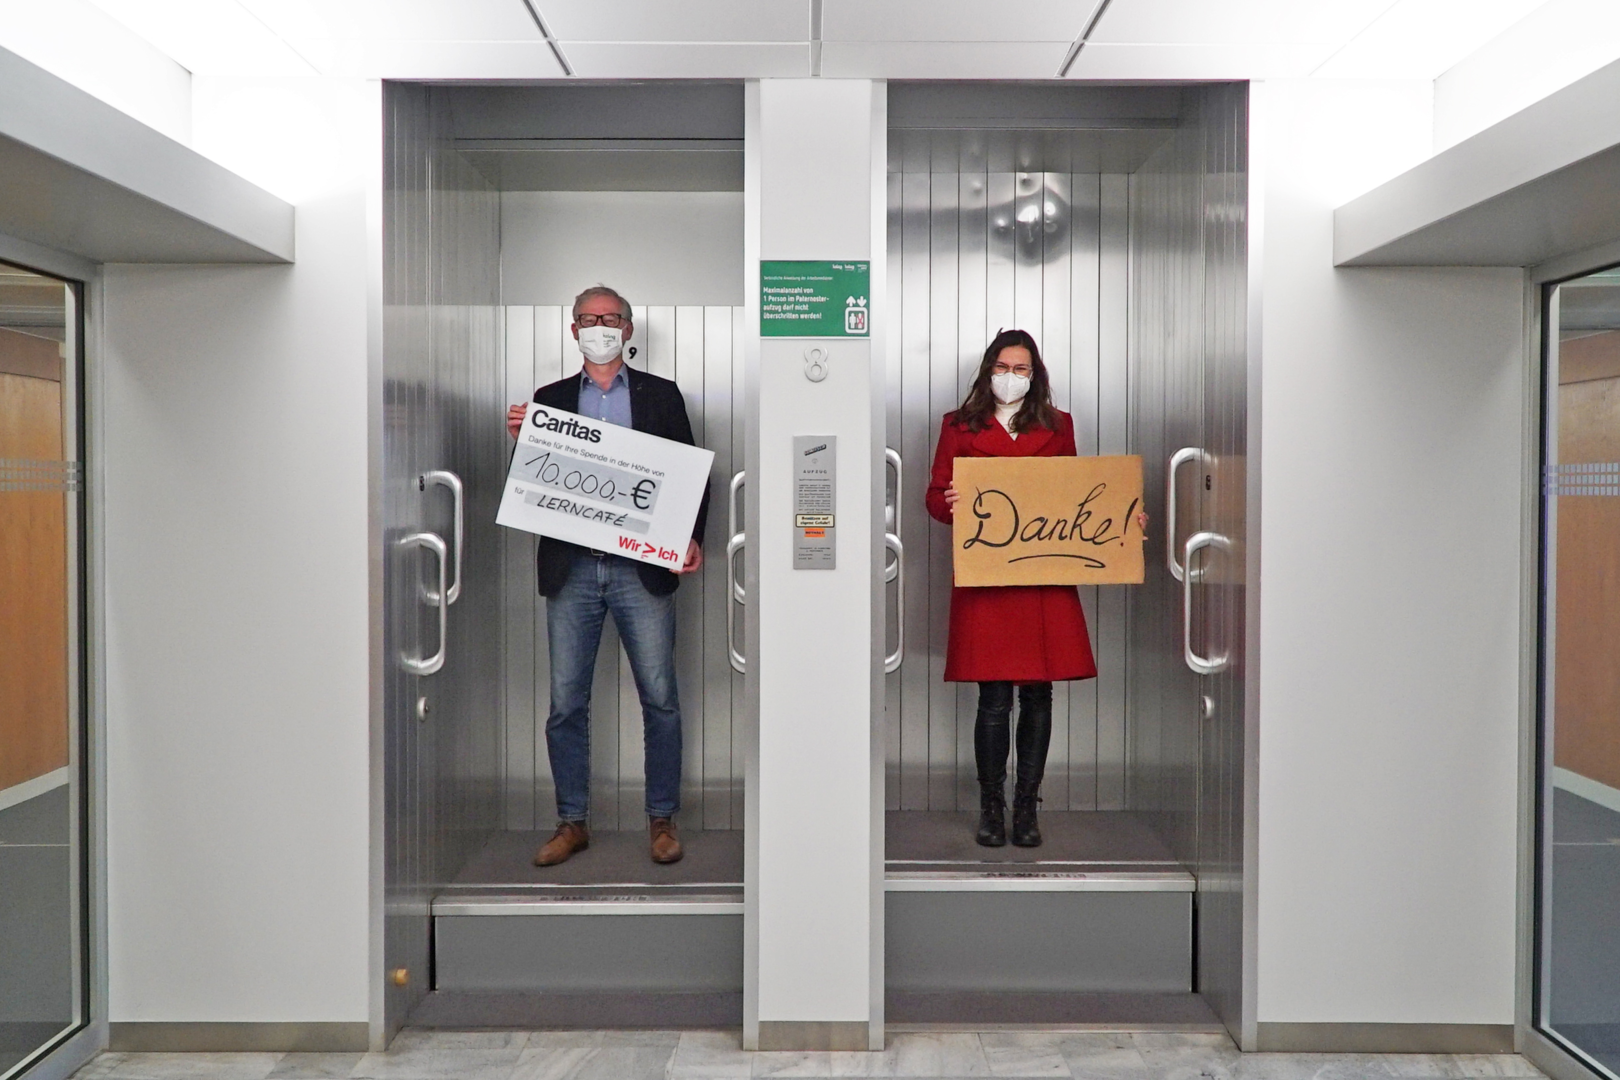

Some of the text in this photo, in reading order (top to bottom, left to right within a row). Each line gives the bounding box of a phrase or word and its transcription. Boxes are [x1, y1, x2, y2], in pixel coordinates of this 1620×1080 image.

[763, 304, 782, 312] aufzug
[629, 346, 637, 360] 9
[804, 346, 829, 383] 8
[531, 409, 602, 444] Caritas
[528, 434, 665, 479] Danke für Ihre Spende in der Höhe von
[515, 486, 525, 495] für
[537, 495, 628, 527] LERNCAFÉ
[962, 481, 1139, 550] Danke!
[618, 535, 642, 553] Wir
[658, 546, 679, 563] Ich
